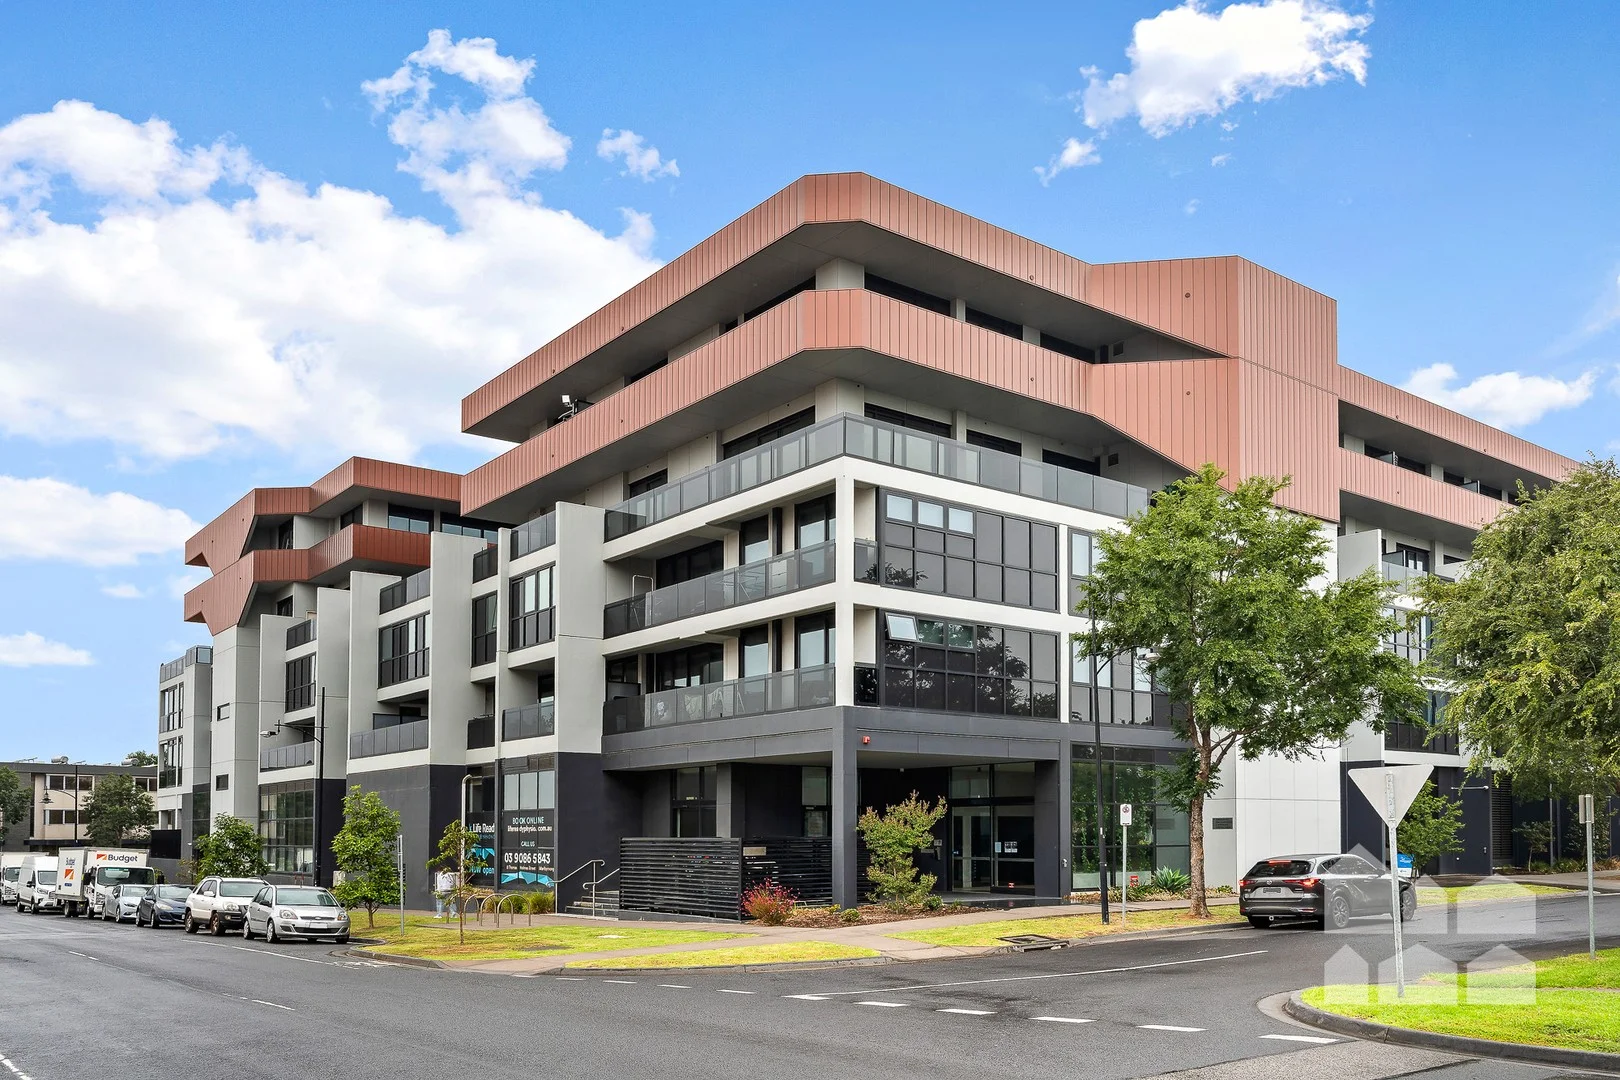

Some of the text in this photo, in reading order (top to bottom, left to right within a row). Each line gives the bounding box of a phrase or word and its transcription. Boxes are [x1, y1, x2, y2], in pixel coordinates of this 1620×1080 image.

[473, 823, 481, 832] Life
[108, 854, 138, 863] Budget
[504, 852, 513, 863] 03
[532, 853, 551, 864] 5843
